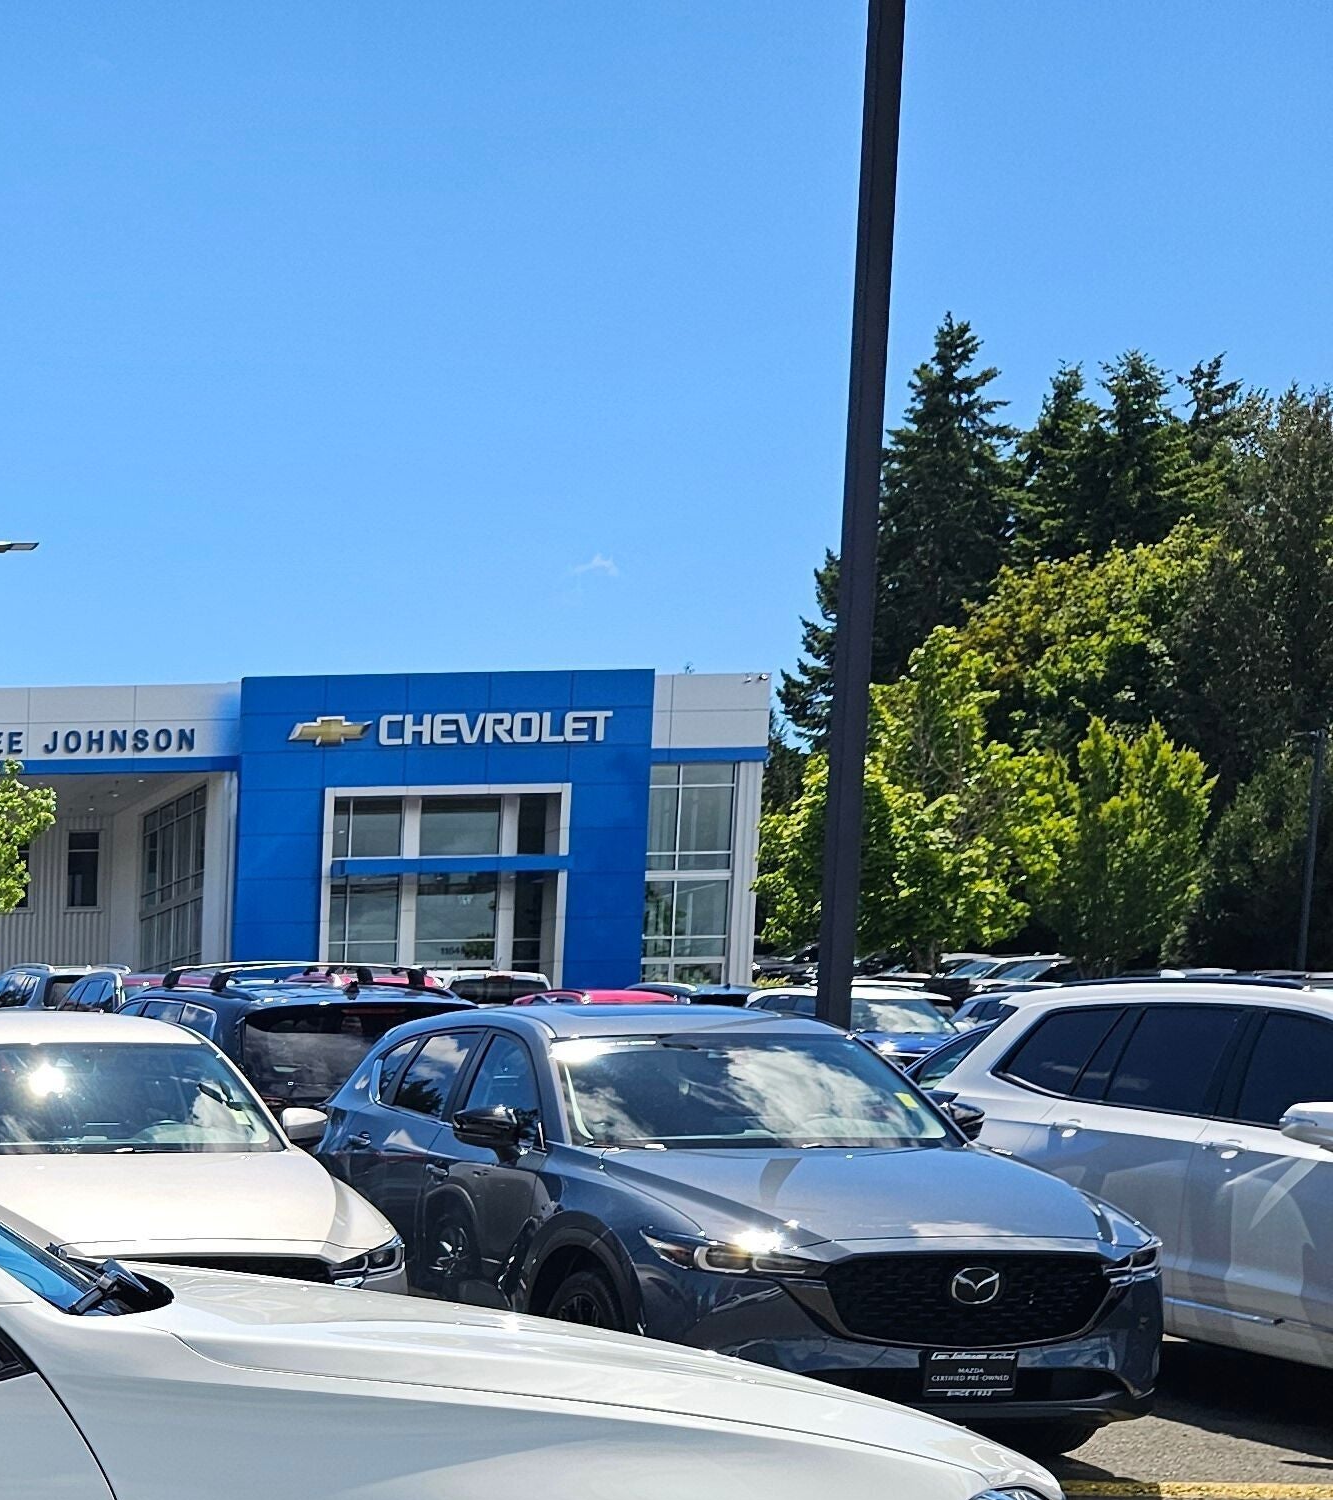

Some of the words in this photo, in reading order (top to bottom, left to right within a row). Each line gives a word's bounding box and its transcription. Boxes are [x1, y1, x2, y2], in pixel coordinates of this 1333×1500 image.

[42, 727, 196, 755] JOHNSON
[378, 710, 614, 746] CHEVROLET
[931, 1374, 965, 1382] CERTIFIED
[967, 1374, 1010, 1382] PRE-OWNED
